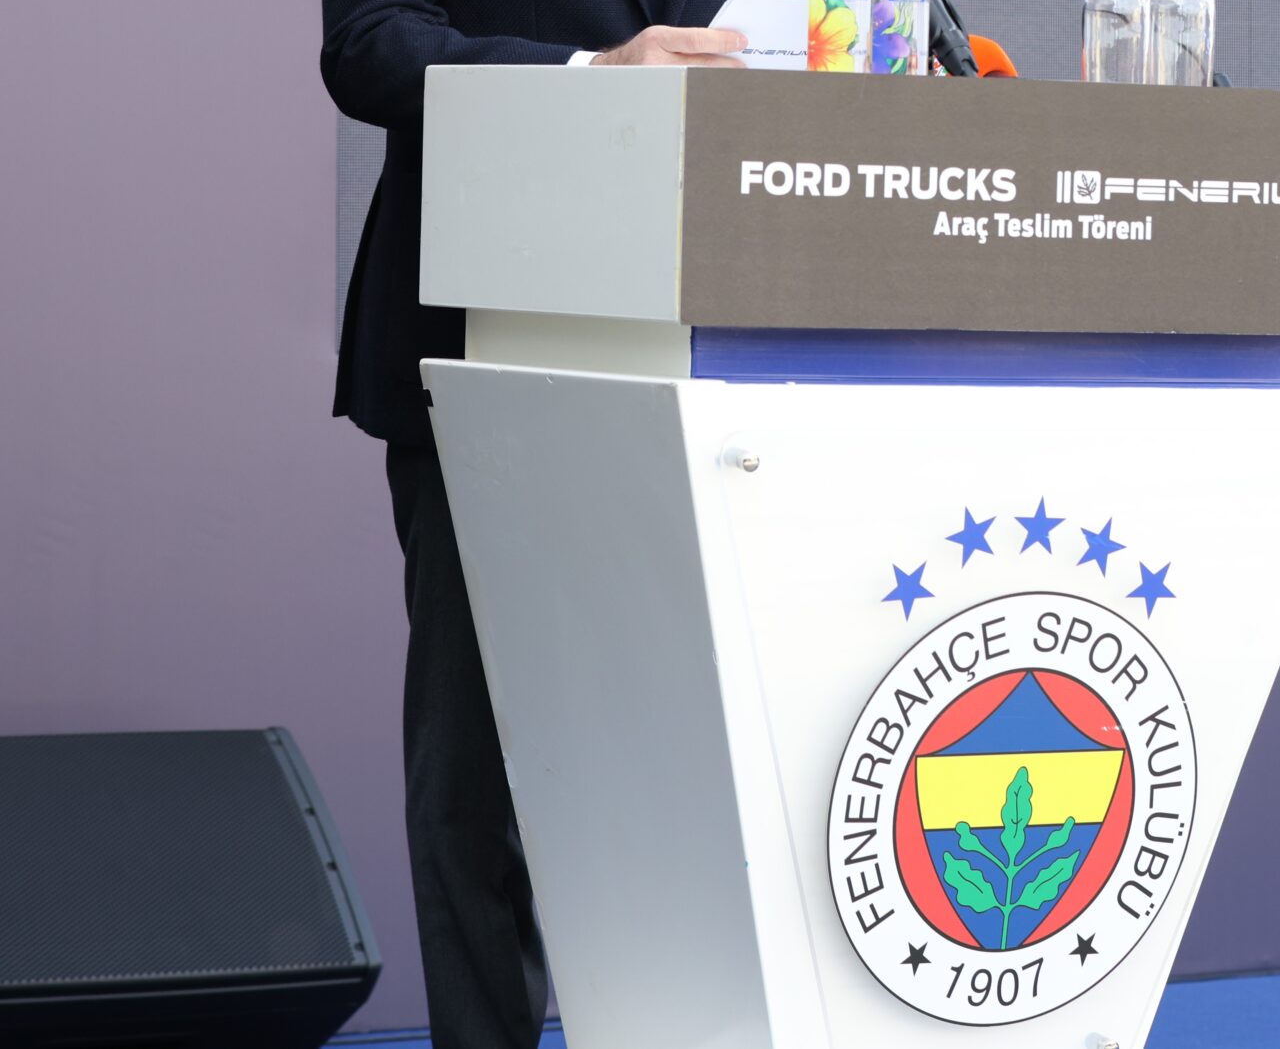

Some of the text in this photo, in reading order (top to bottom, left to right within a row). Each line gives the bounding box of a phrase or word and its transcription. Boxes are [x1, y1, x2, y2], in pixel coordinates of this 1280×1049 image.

[740, 161, 1017, 202] FORD TRUCKS
[933, 211, 1152, 244] Araç Teslim Töreni
[843, 611, 1185, 934] FENERBAHÇE SPOR KULÜBÜ
[945, 957, 1045, 1007] 1907
